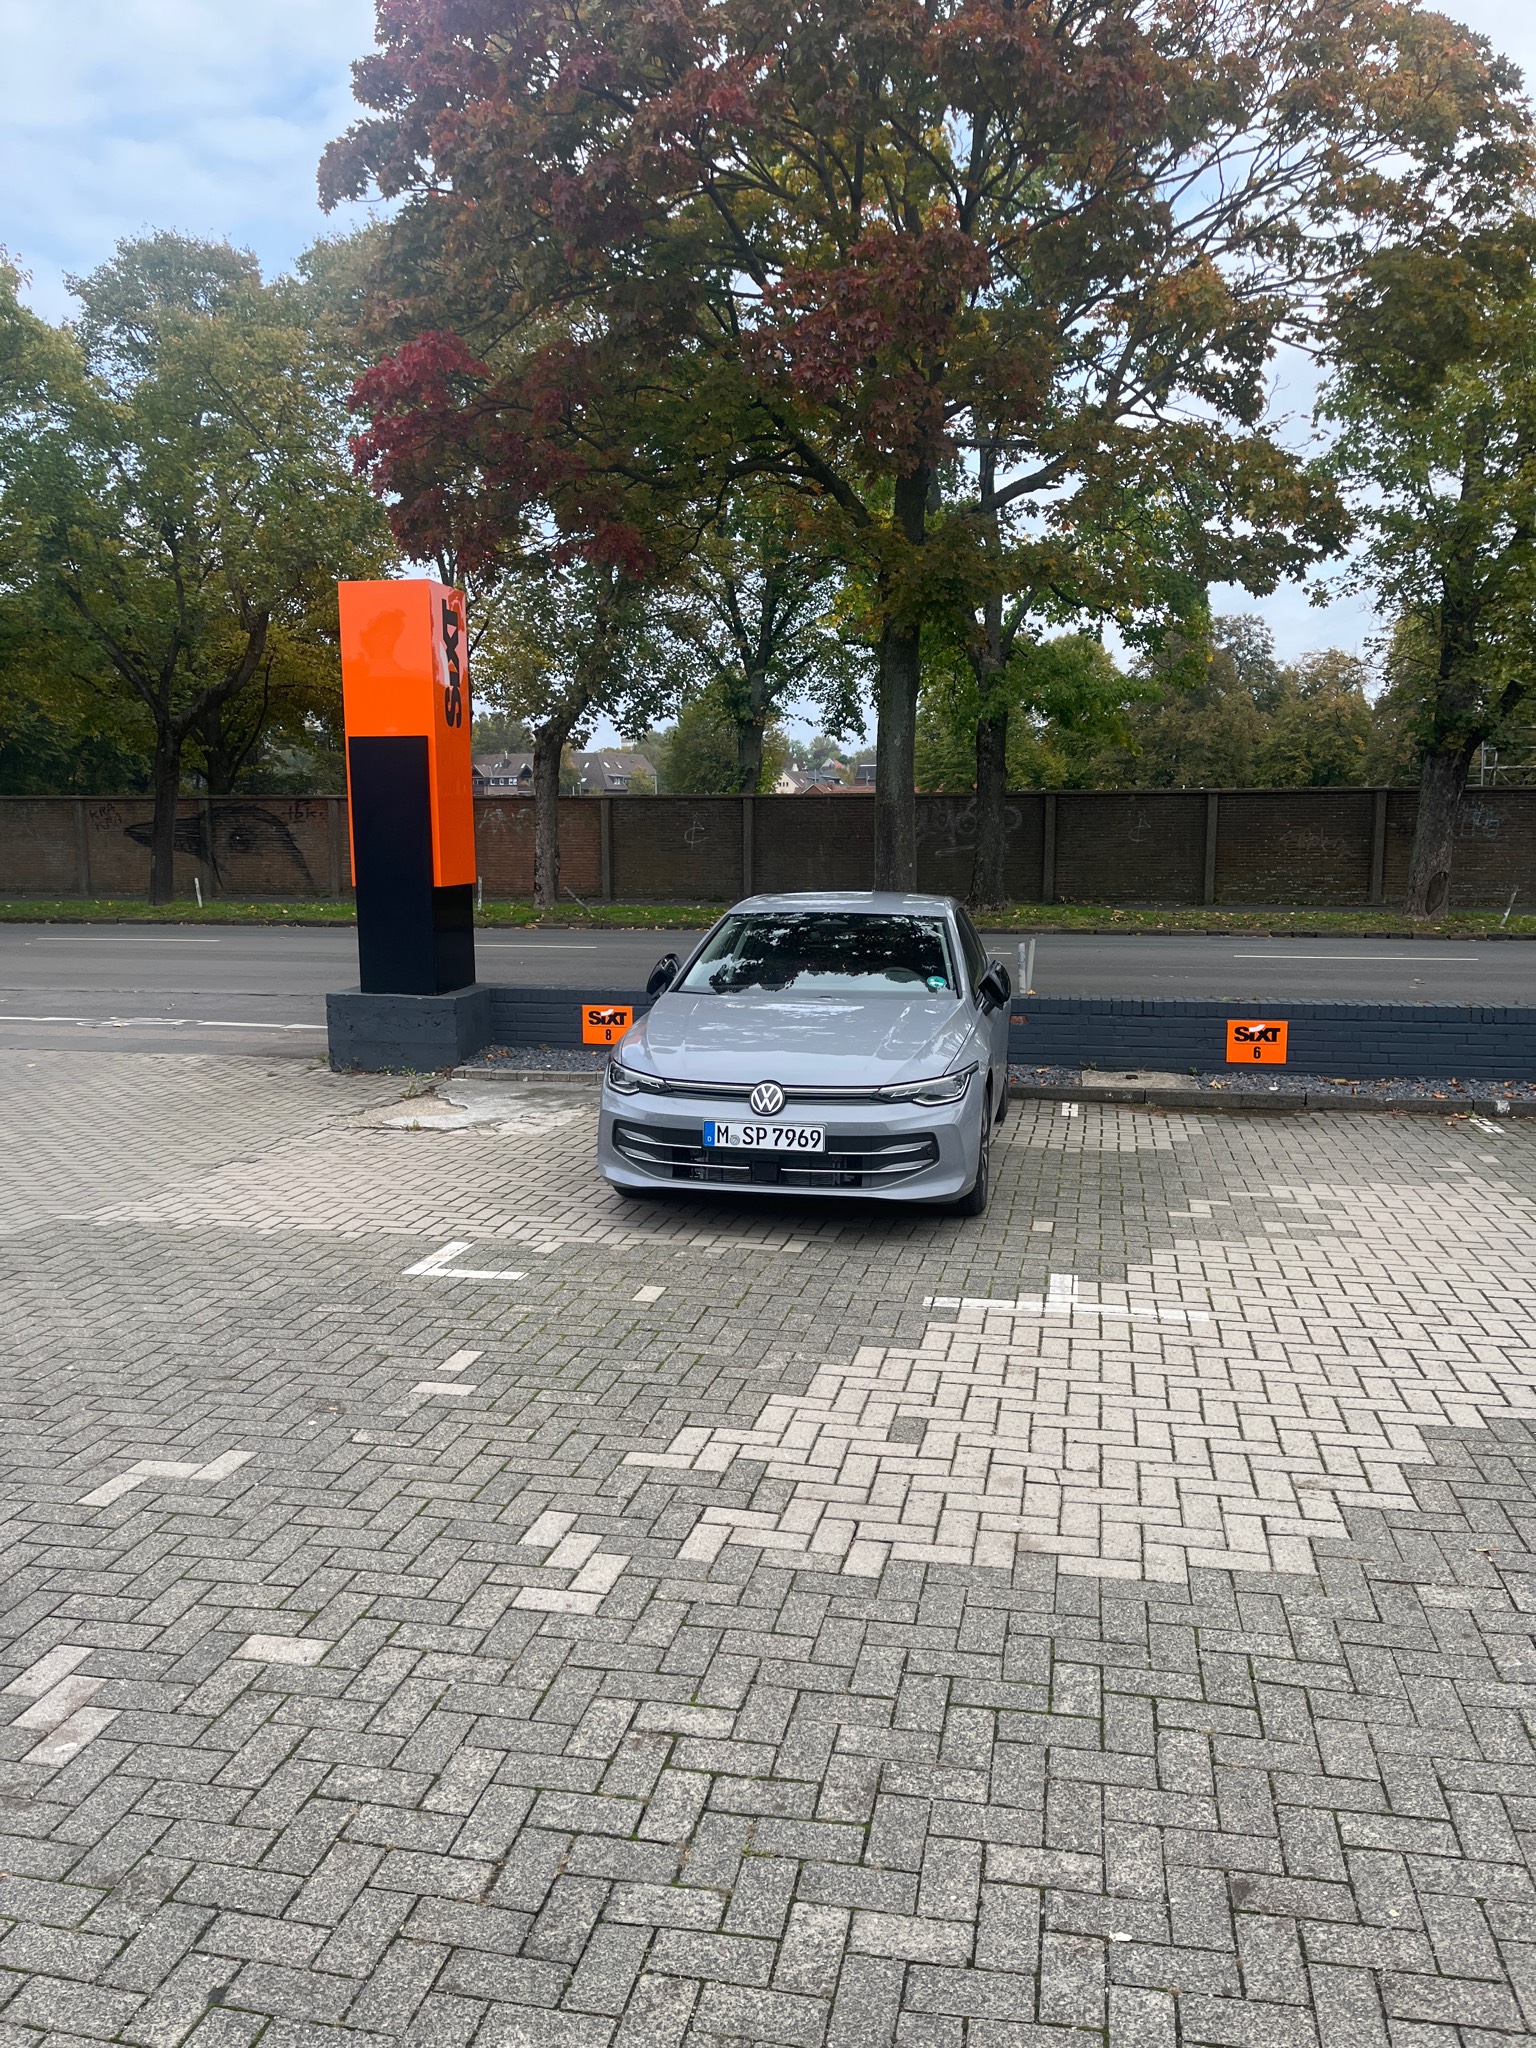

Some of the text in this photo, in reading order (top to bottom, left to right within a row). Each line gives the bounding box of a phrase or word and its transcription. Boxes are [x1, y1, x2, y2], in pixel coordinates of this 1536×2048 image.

[441, 598, 462, 729] SIXT
[588, 1009, 627, 1026] SIXT
[605, 1028, 612, 1041] 8
[1234, 1024, 1281, 1043] SIXT
[1253, 1046, 1262, 1060] 6
[772, 1128, 822, 1149] 7969
